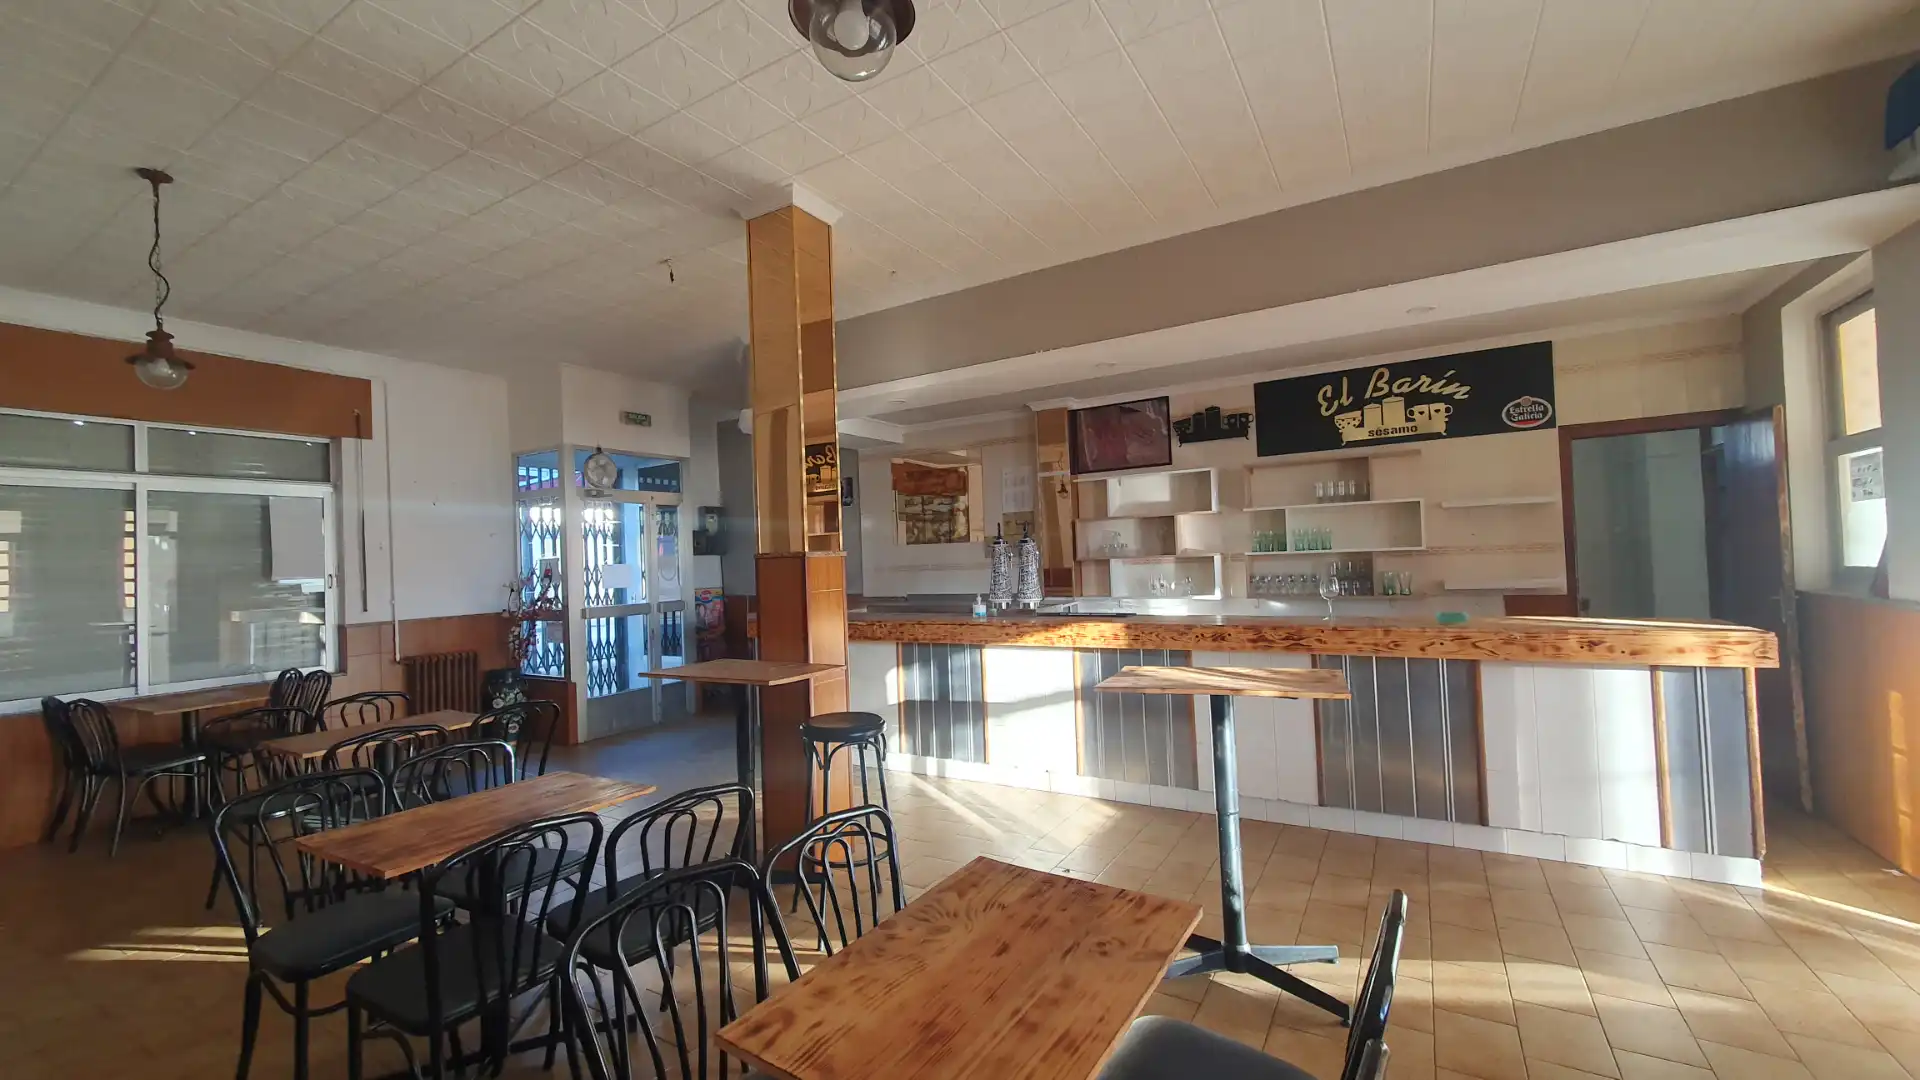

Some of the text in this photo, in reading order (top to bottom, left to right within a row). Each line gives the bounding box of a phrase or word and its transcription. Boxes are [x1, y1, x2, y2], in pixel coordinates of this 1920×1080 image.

[1317, 367, 1472, 416] El Barín
[1509, 403, 1544, 414] Estrella
[1510, 412, 1543, 421] Galicia
